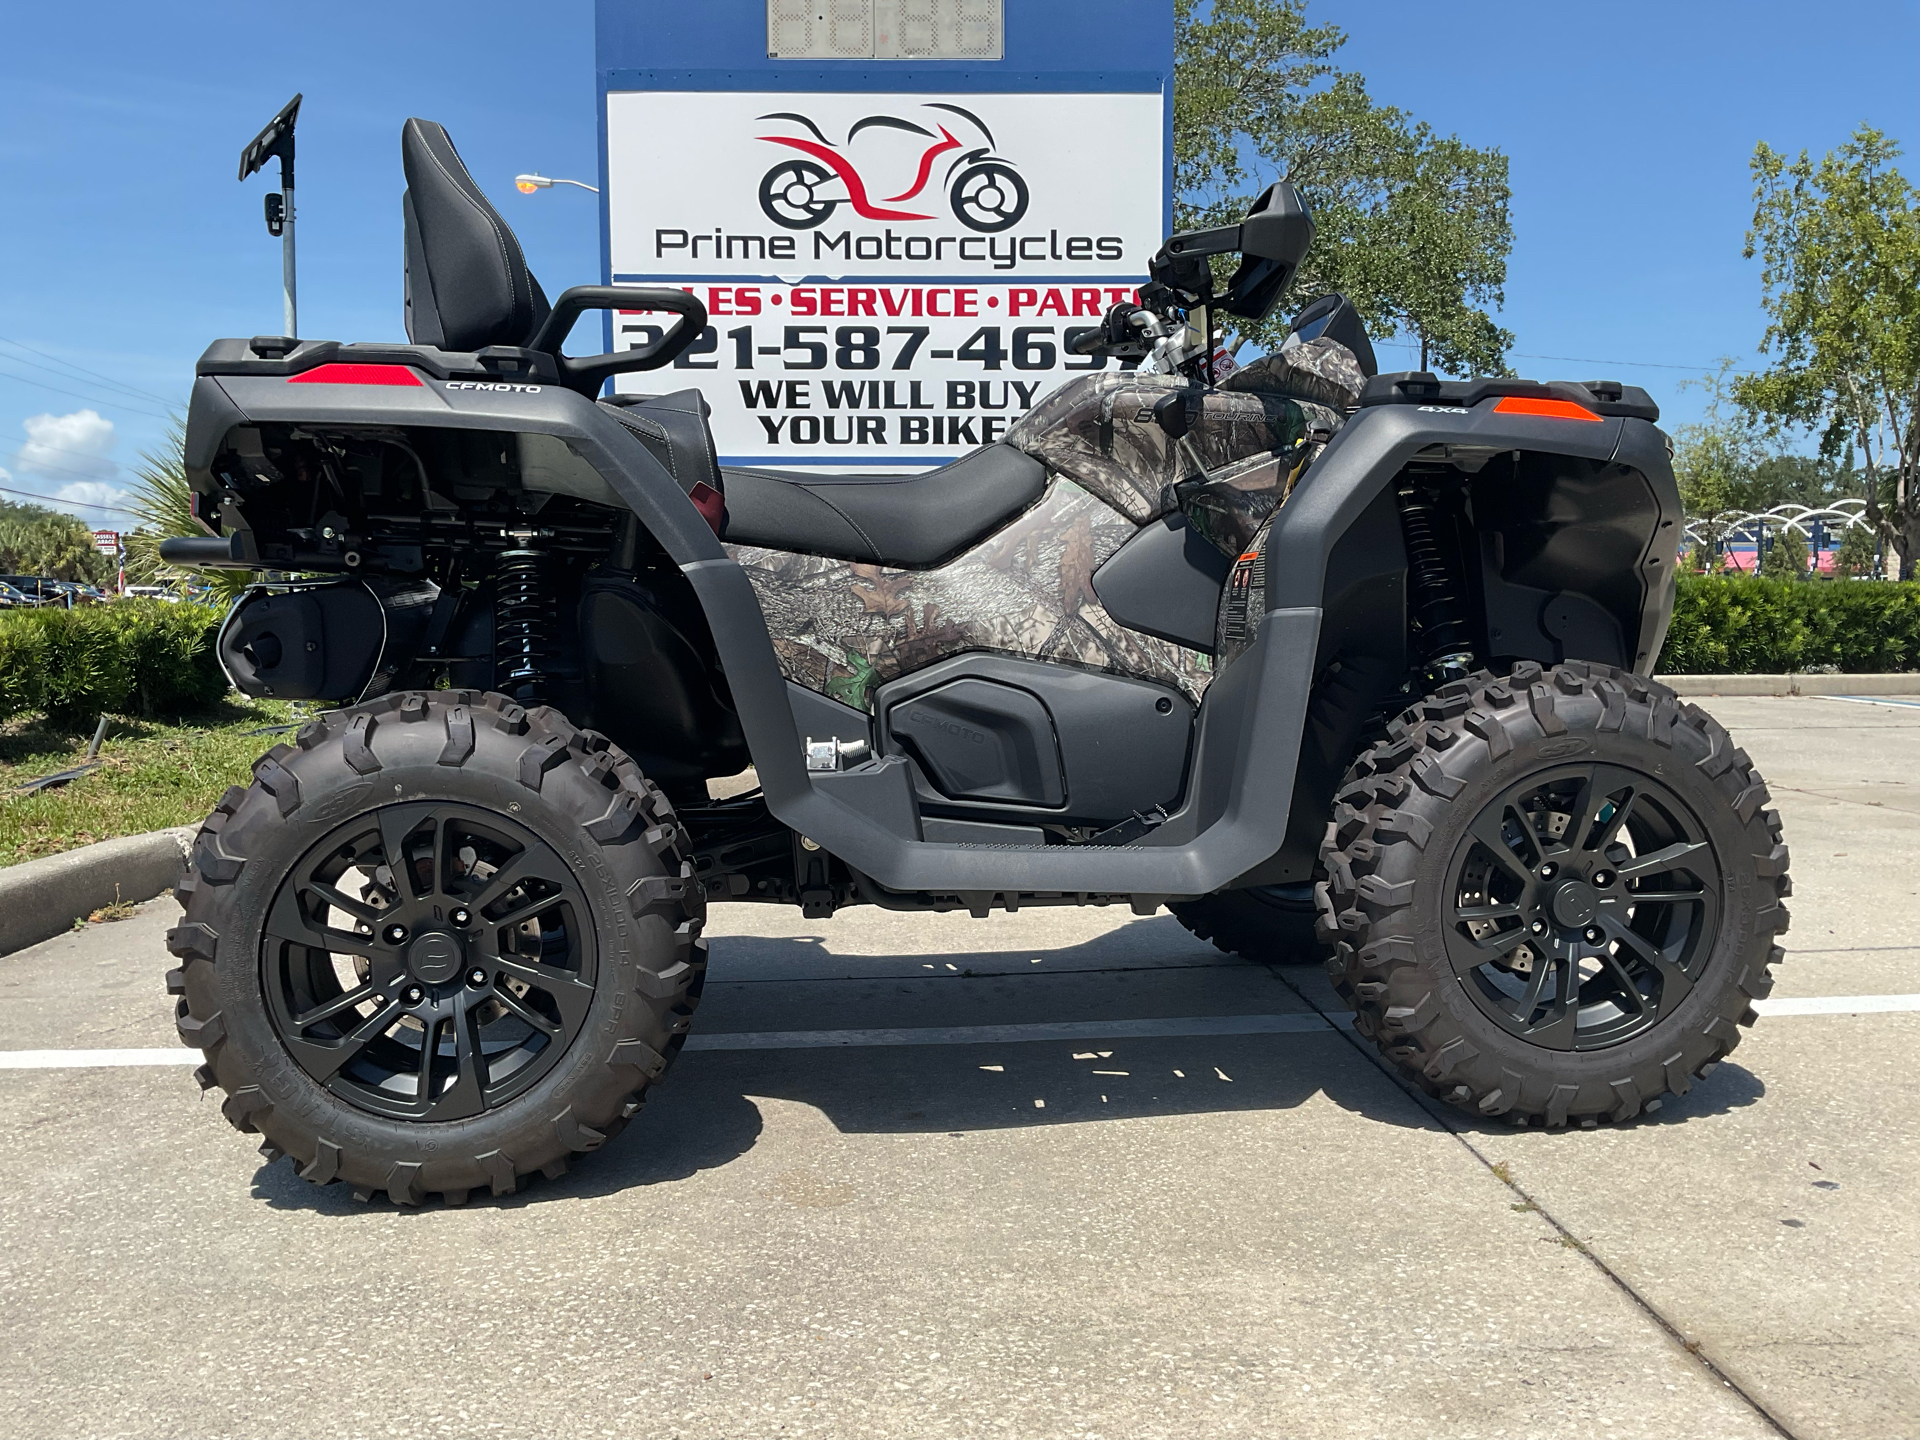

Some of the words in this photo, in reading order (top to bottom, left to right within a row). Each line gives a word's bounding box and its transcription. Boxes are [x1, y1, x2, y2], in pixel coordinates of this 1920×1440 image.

[656, 228, 796, 259] Prime
[814, 228, 1123, 270] Motorcycles
[790, 287, 979, 317] SERVICE
[1008, 288, 1142, 317] PART
[621, 324, 1139, 371] 321-587-469
[445, 382, 542, 394] CFMOTO
[738, 380, 811, 409] WE
[821, 380, 934, 410] WILL
[946, 380, 1042, 410] BUY
[757, 416, 888, 445] YOUR
[900, 416, 1020, 445] BIKE
[1203, 410, 1278, 423] TOURING
[909, 709, 985, 745] CFMOTO
